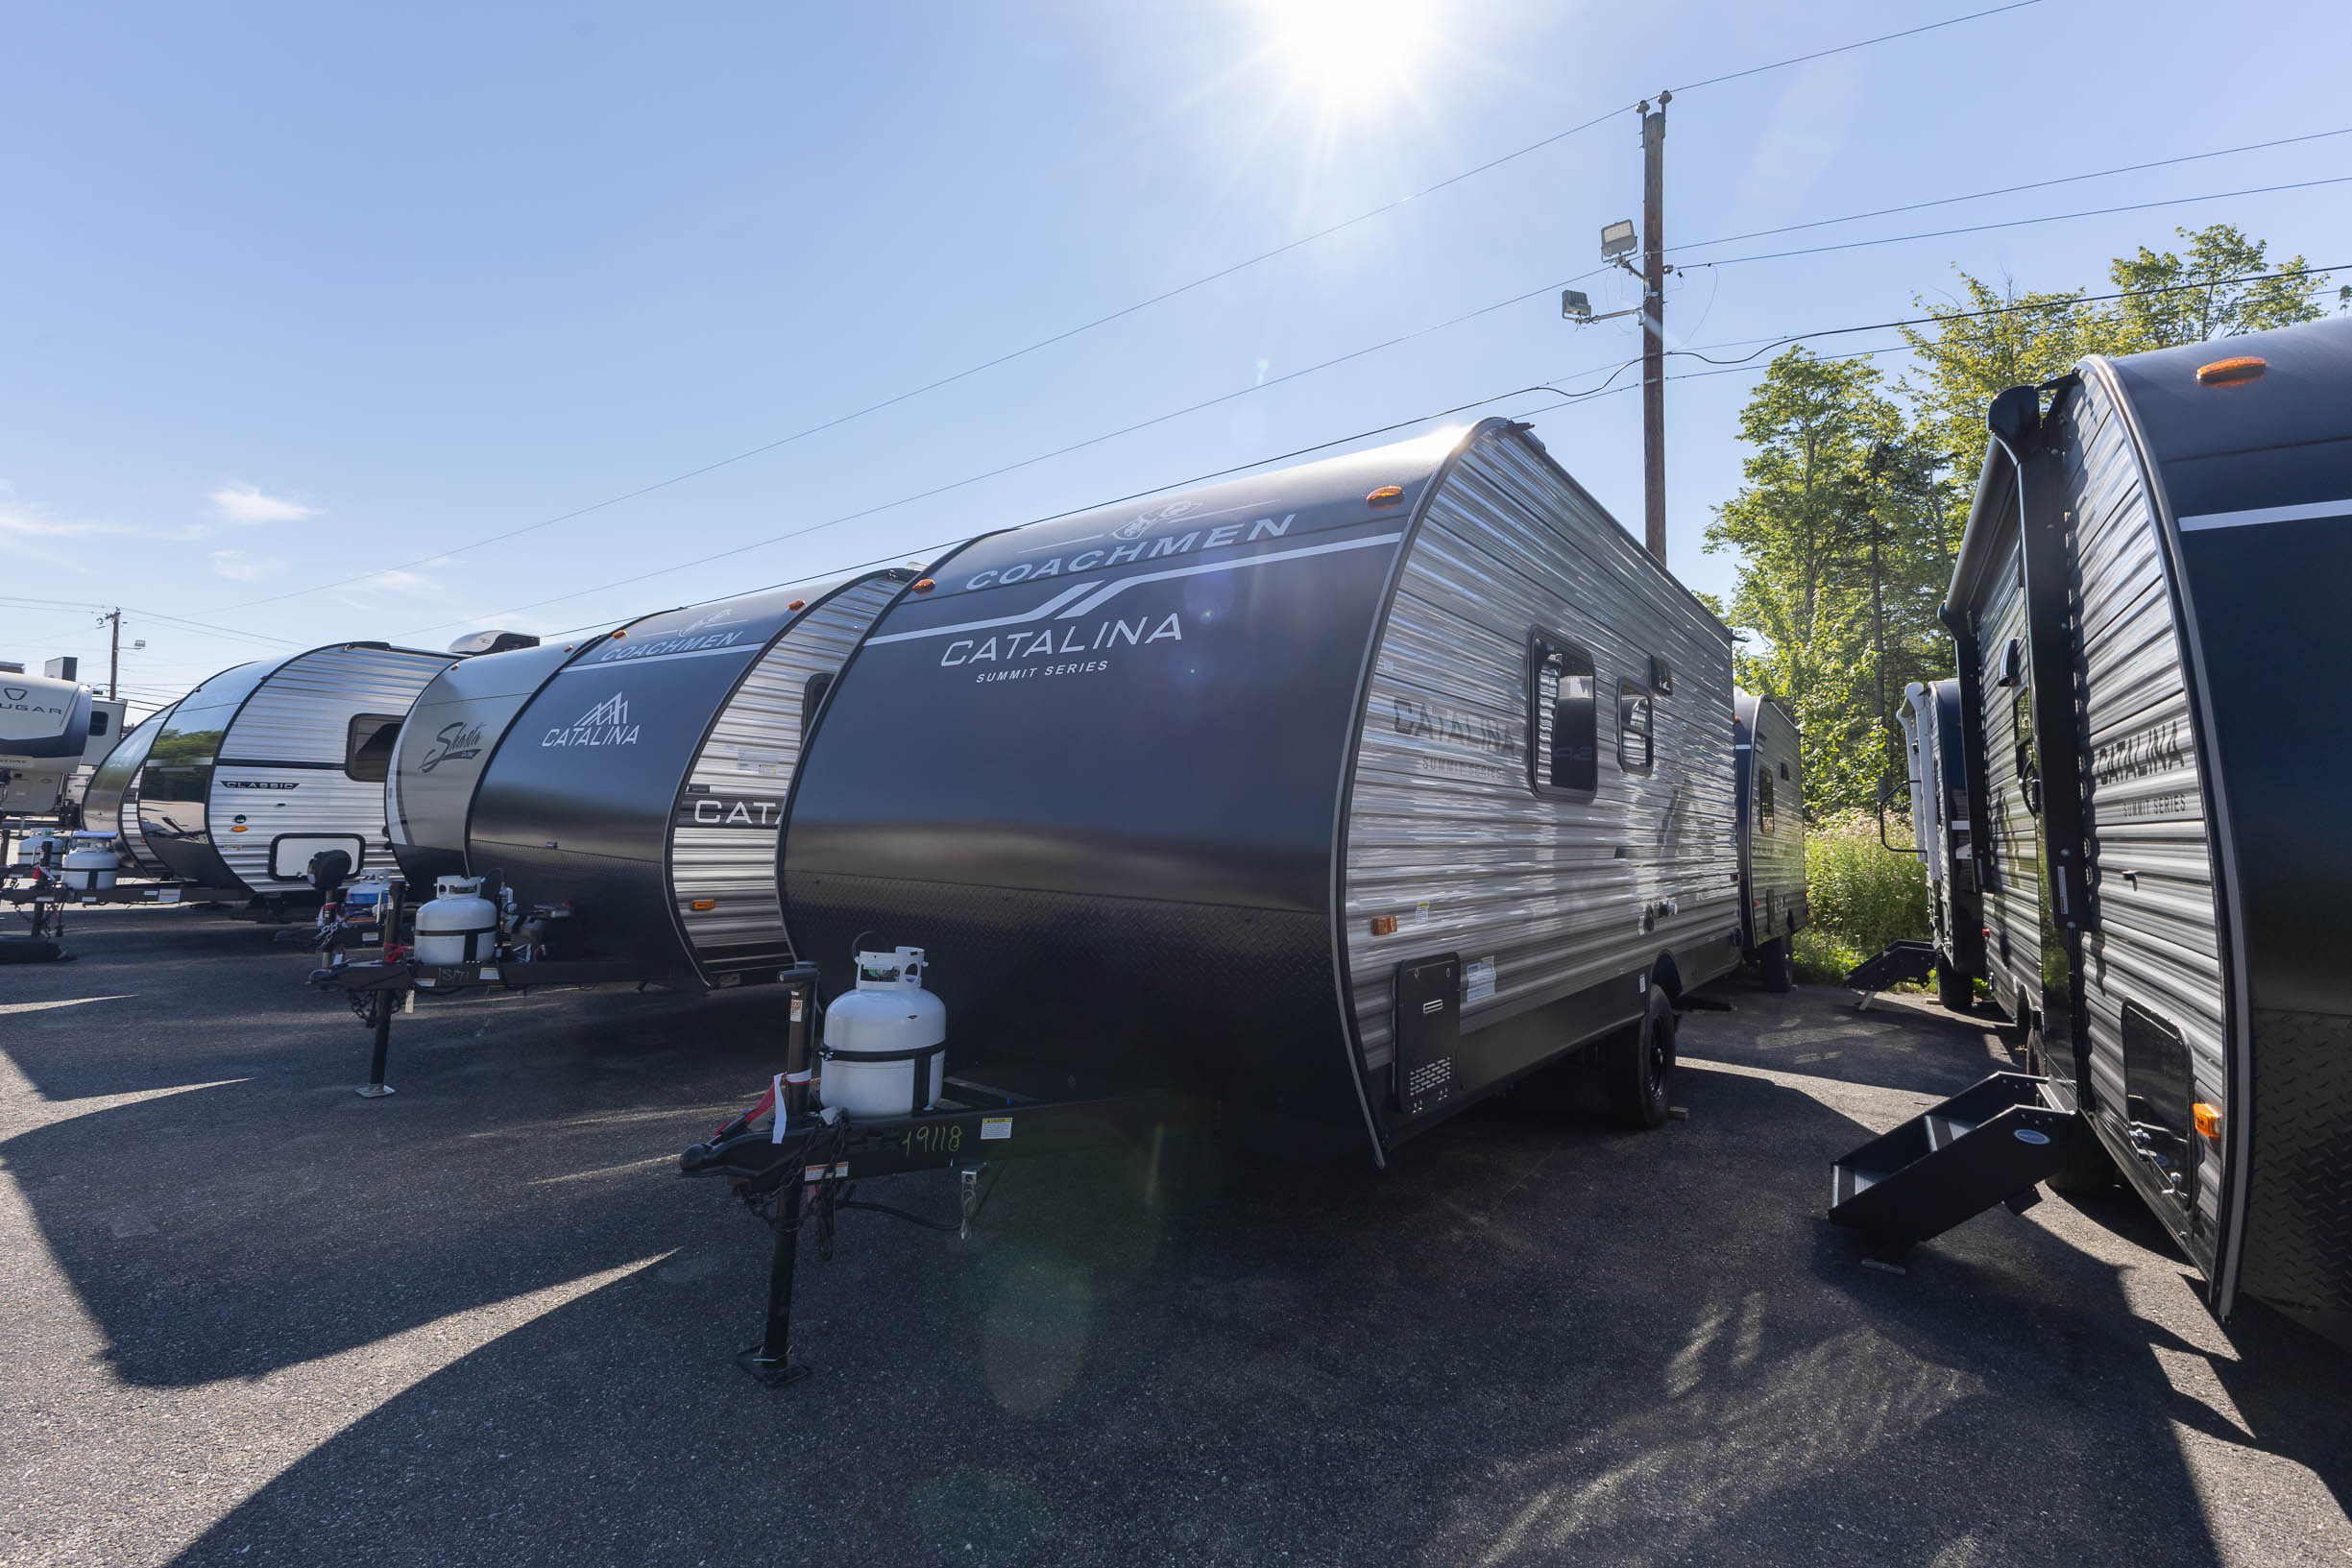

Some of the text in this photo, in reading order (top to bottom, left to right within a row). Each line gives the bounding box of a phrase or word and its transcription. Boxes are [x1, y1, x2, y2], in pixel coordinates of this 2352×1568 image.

[966, 514, 1297, 591] COACHMEN
[600, 631, 743, 662] COACHMEN
[941, 613, 1183, 666] CATALINA
[976, 660, 1108, 683] SUMMIT SERIES
[542, 725, 640, 746] CATALINA
[1394, 698, 1515, 756] CATALINA
[2097, 721, 2185, 785] CATALINA
[227, 782, 295, 790] CLASSIC
[694, 800, 782, 825] CAT
[2122, 794, 2186, 817] SUMMIT SERIES
